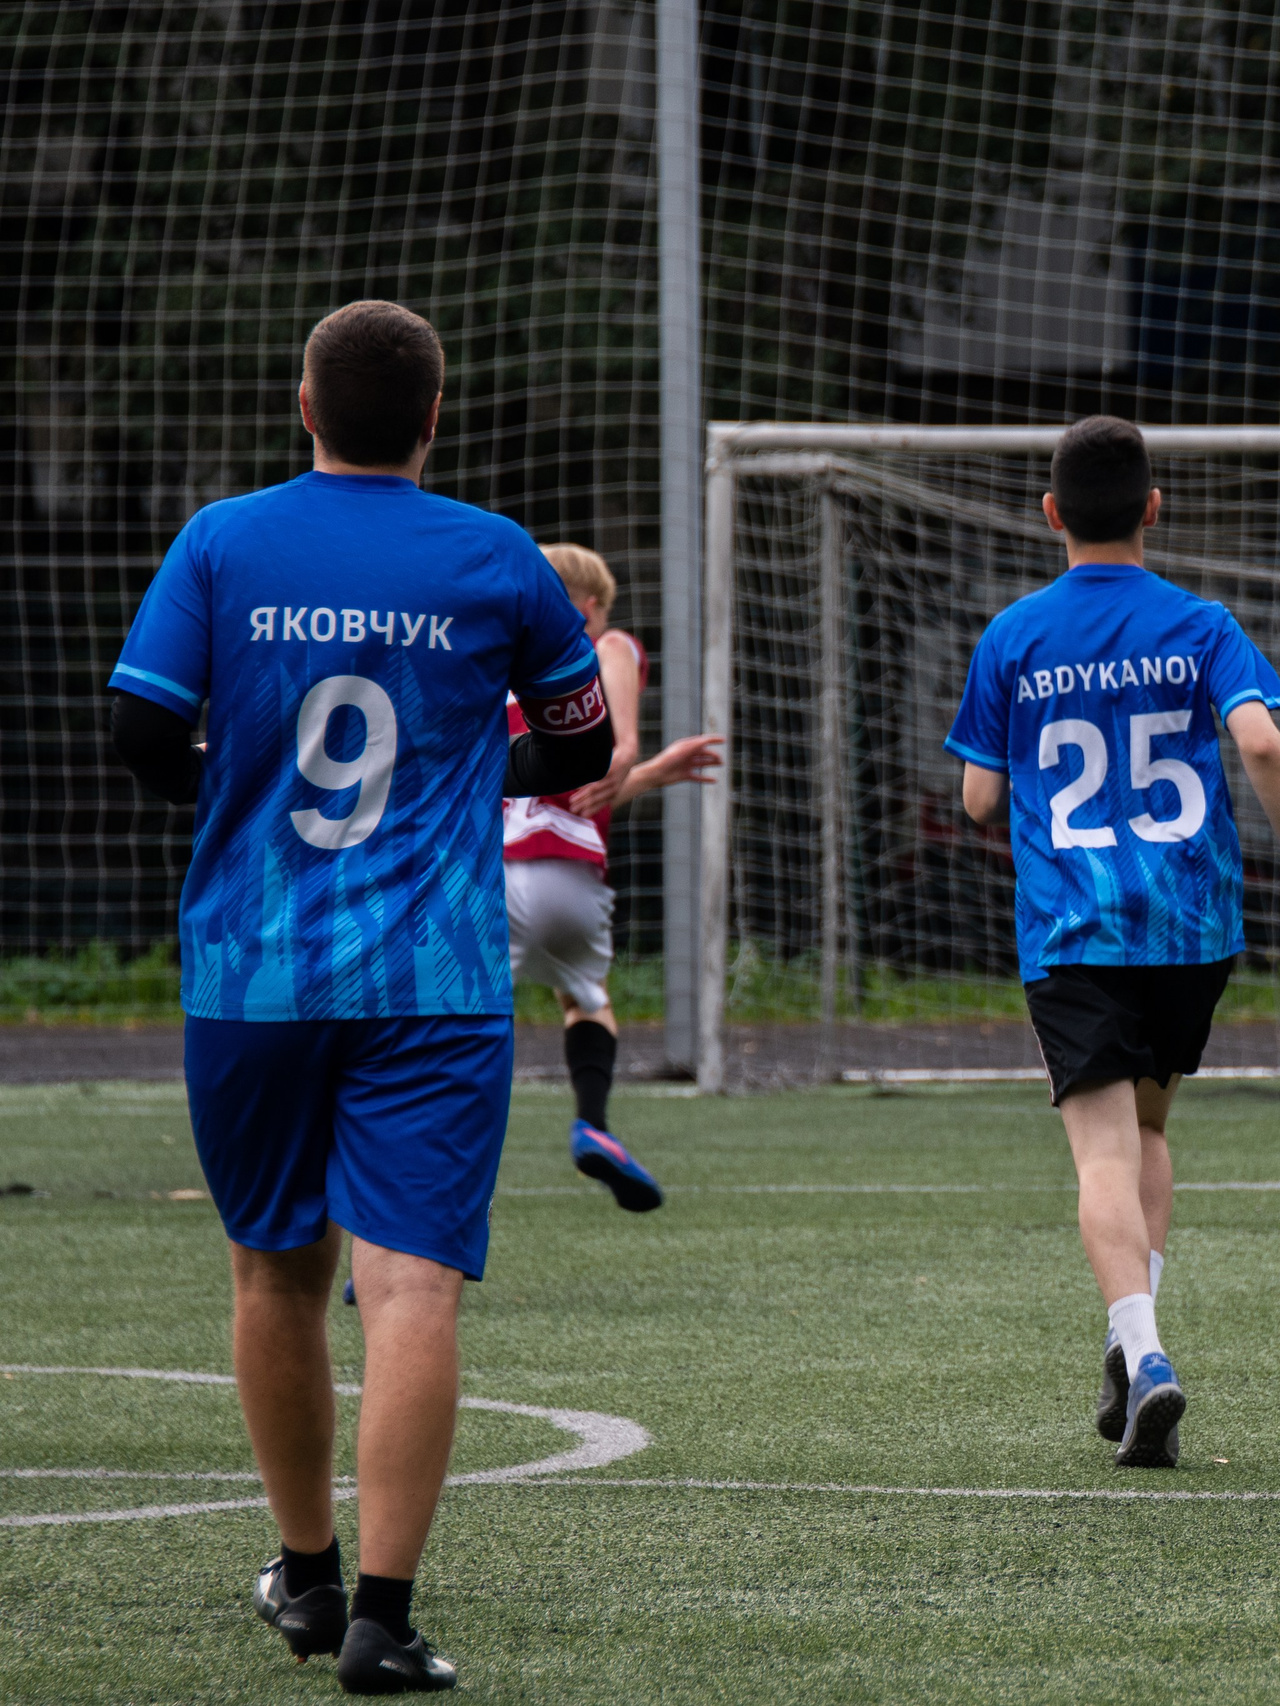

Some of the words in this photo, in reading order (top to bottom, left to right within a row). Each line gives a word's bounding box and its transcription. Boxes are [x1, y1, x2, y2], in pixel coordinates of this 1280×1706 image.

[249, 606, 454, 650] ЯКОВЧУК
[289, 675, 397, 850] 9
[1038, 709, 1206, 850] 25
